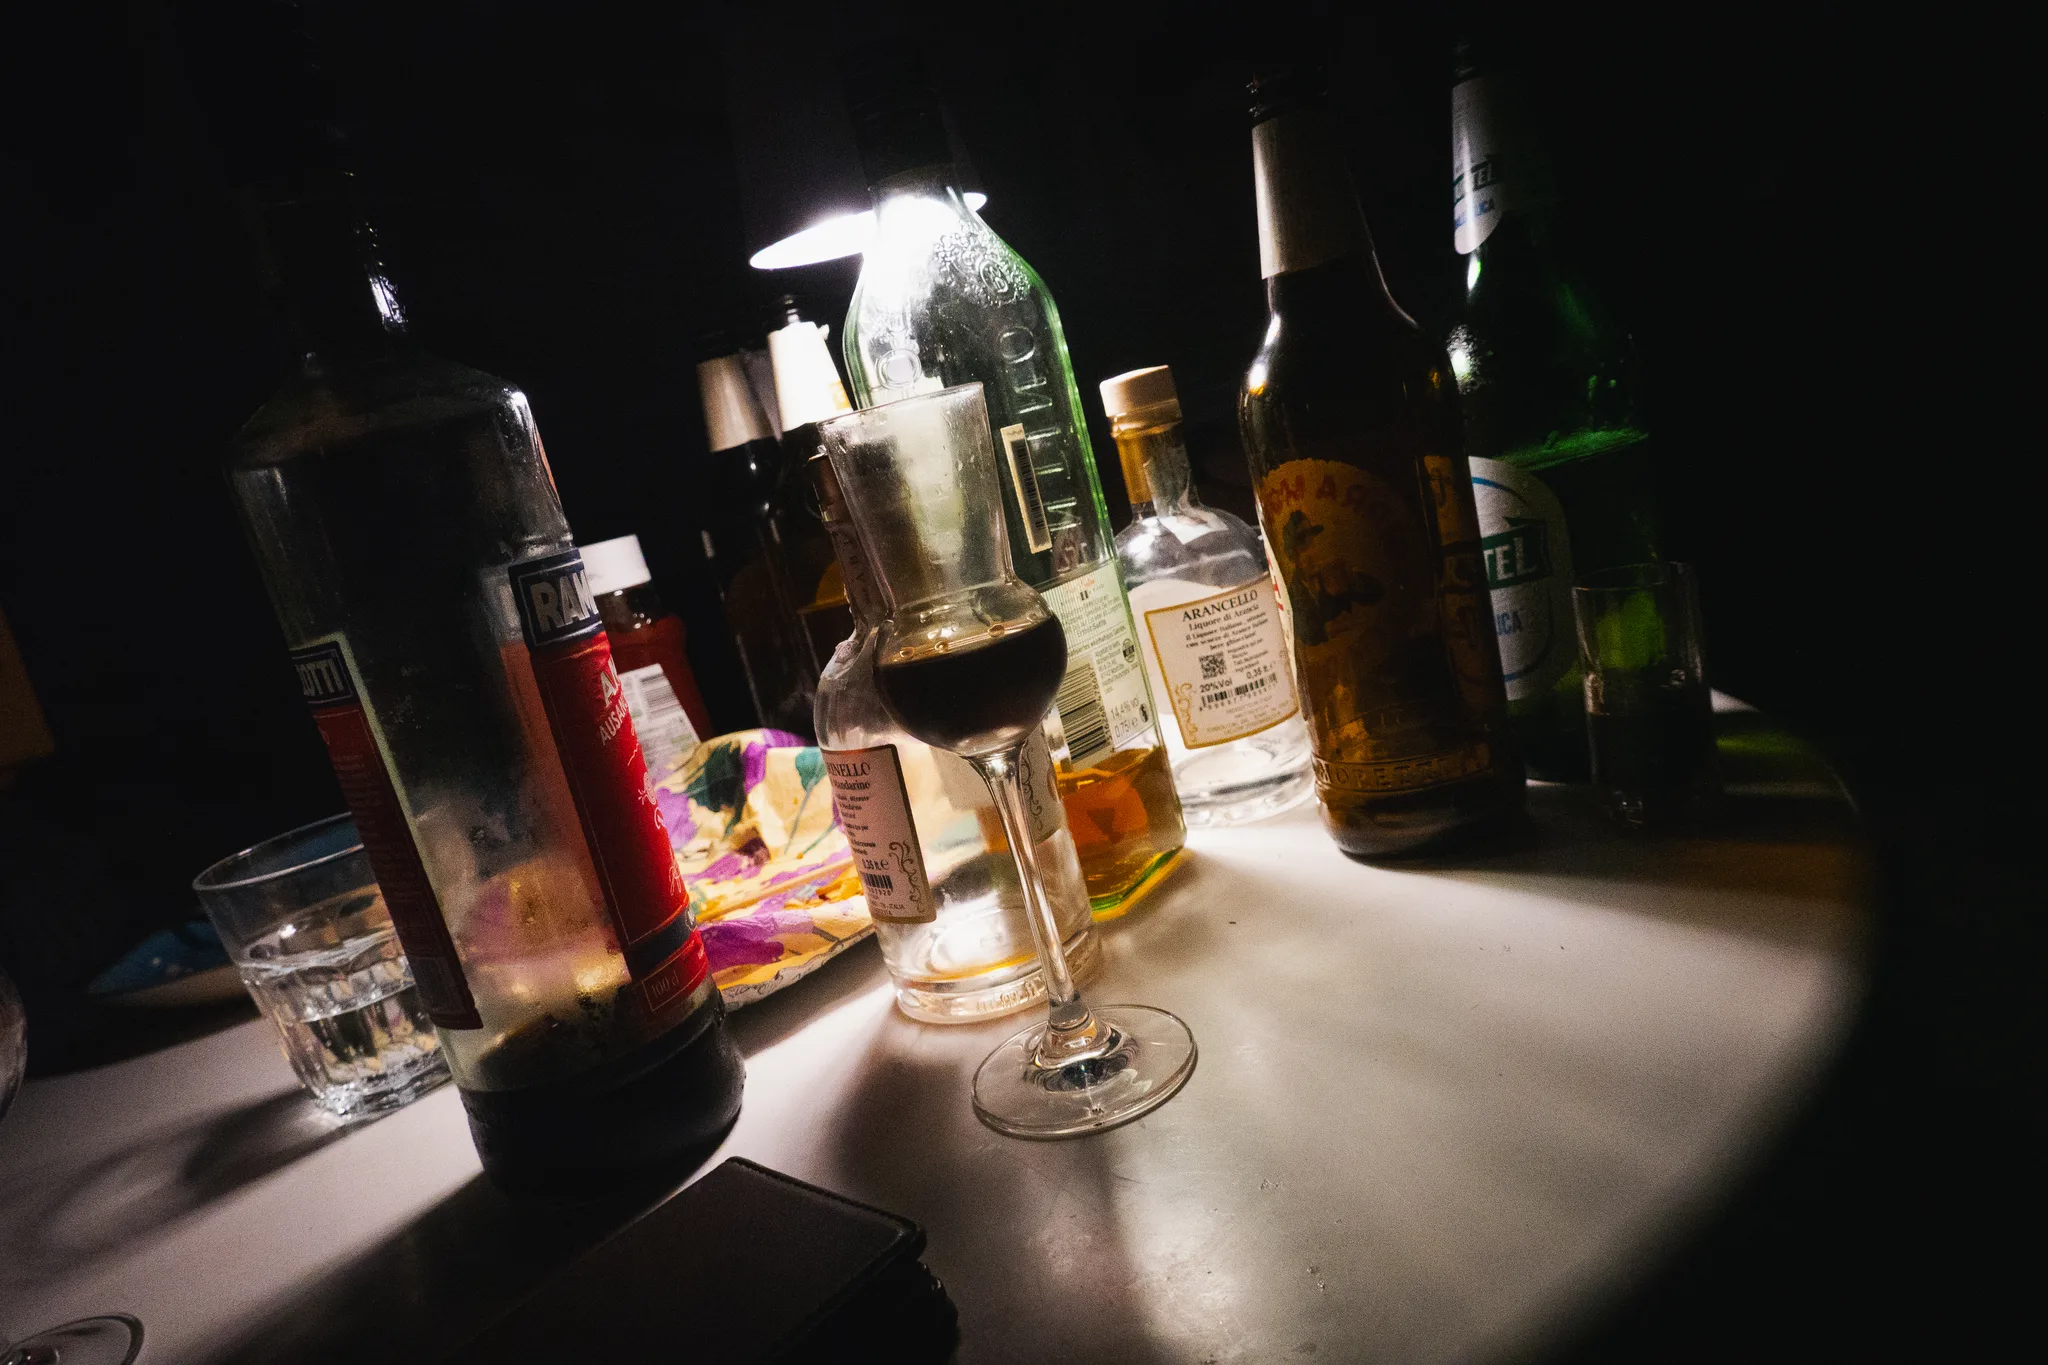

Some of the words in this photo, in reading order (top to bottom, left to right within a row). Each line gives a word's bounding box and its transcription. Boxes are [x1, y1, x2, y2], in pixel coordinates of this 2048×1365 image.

[1182, 589, 1259, 623] ARANCELLO
[1189, 617, 1221, 631] Liquore
[1223, 612, 1233, 621] di
[1234, 604, 1260, 619] Arancia
[651, 976, 670, 998] 100
